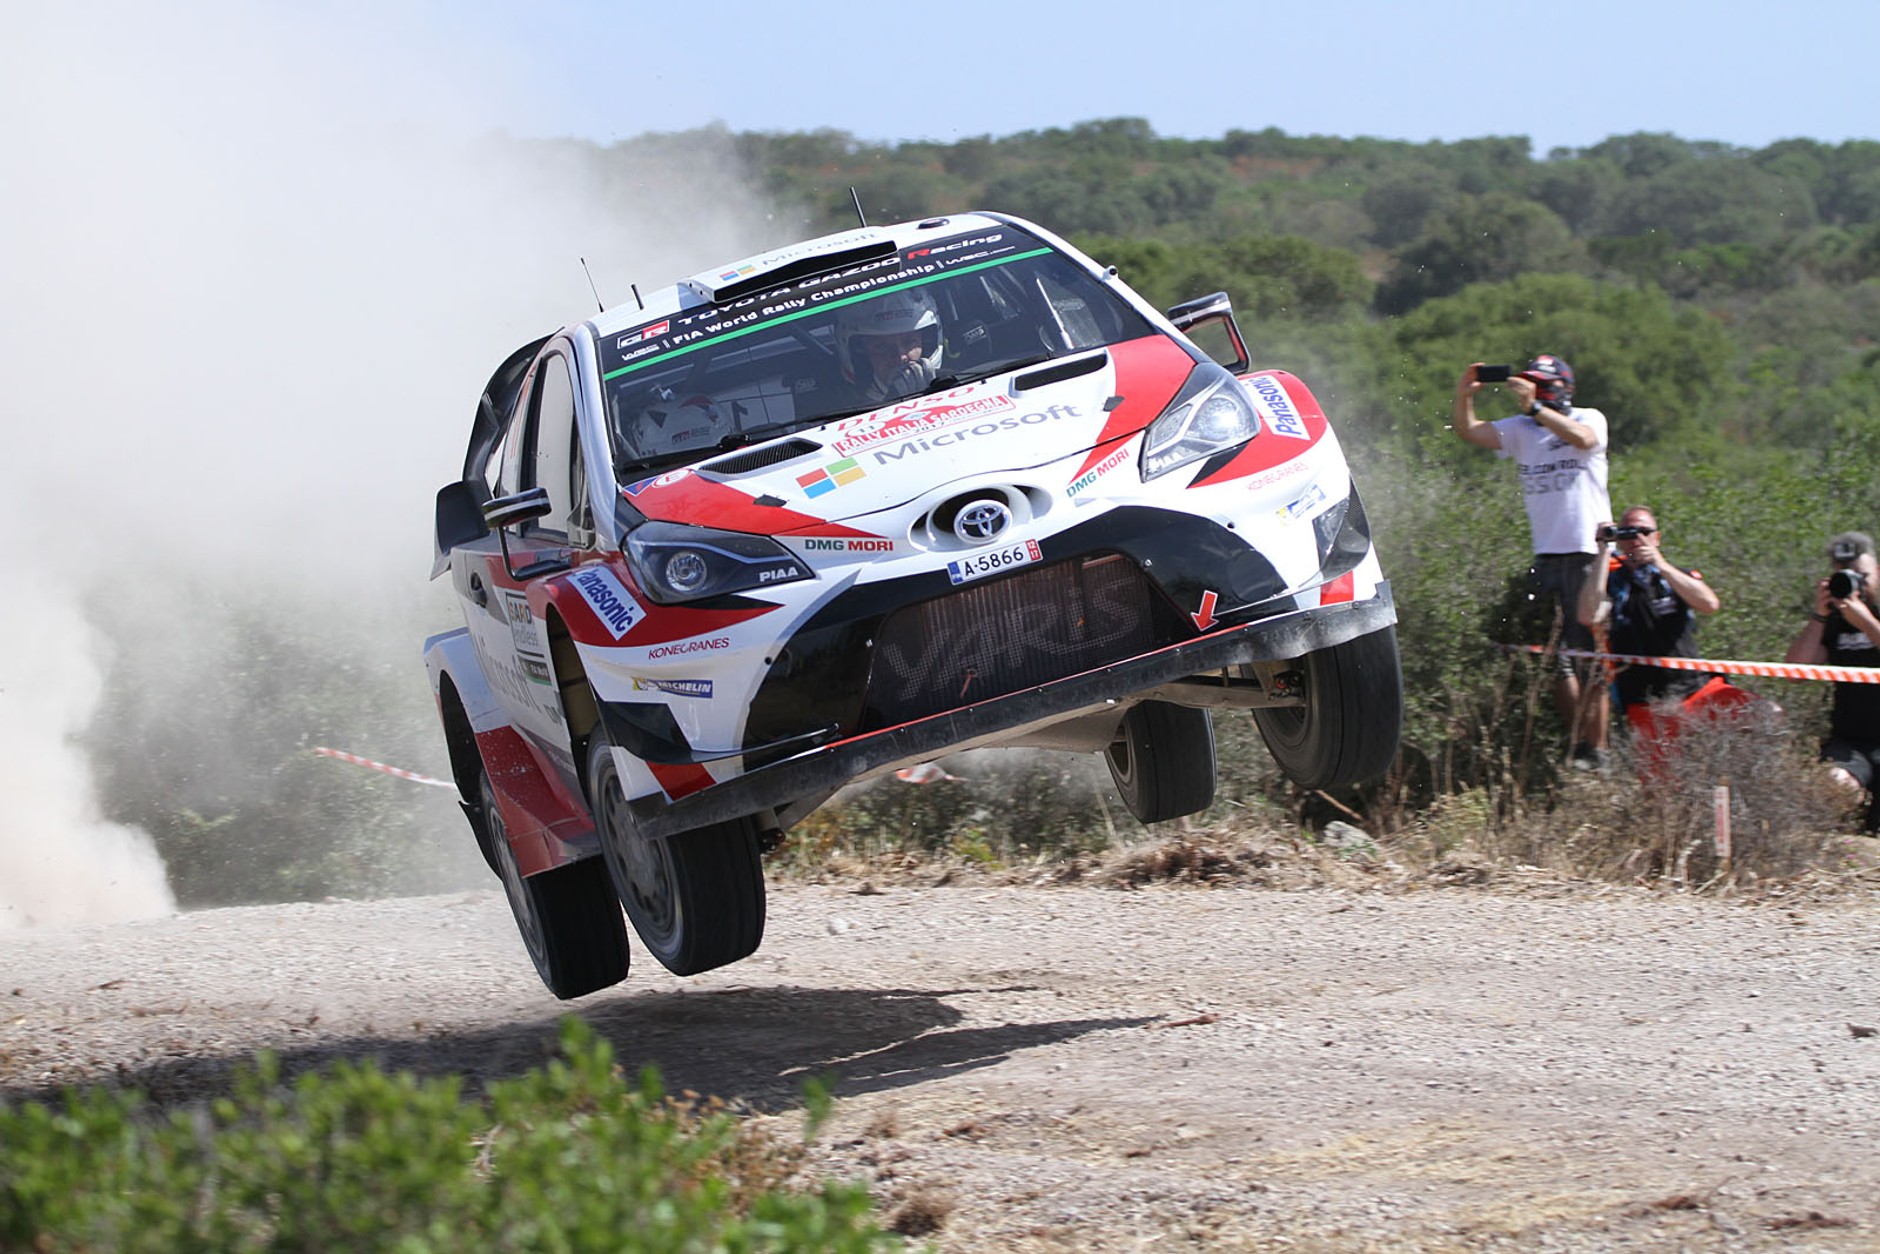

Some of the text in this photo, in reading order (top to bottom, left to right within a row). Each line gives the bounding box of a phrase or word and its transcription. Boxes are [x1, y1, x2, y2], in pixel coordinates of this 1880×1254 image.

[678, 287, 791, 325] TOYOTA
[798, 257, 901, 289] GAZOO
[907, 234, 1002, 260] Racing
[673, 330, 703, 345] FIA
[705, 312, 758, 333] World
[762, 298, 807, 316] Rally
[811, 263, 935, 301] Championship
[838, 386, 975, 431] DENSO
[841, 430, 884, 451] RALLY
[885, 418, 929, 437] ITALIA
[931, 396, 1000, 423] SARDEGNA
[872, 404, 1083, 465] Microsoft
[1066, 448, 1130, 498] DMG MORI
[804, 539, 893, 551] DMG MORI
[758, 566, 799, 582] PIAA
[648, 637, 730, 660] KONECRANES
[657, 681, 711, 694] MICHELIN
